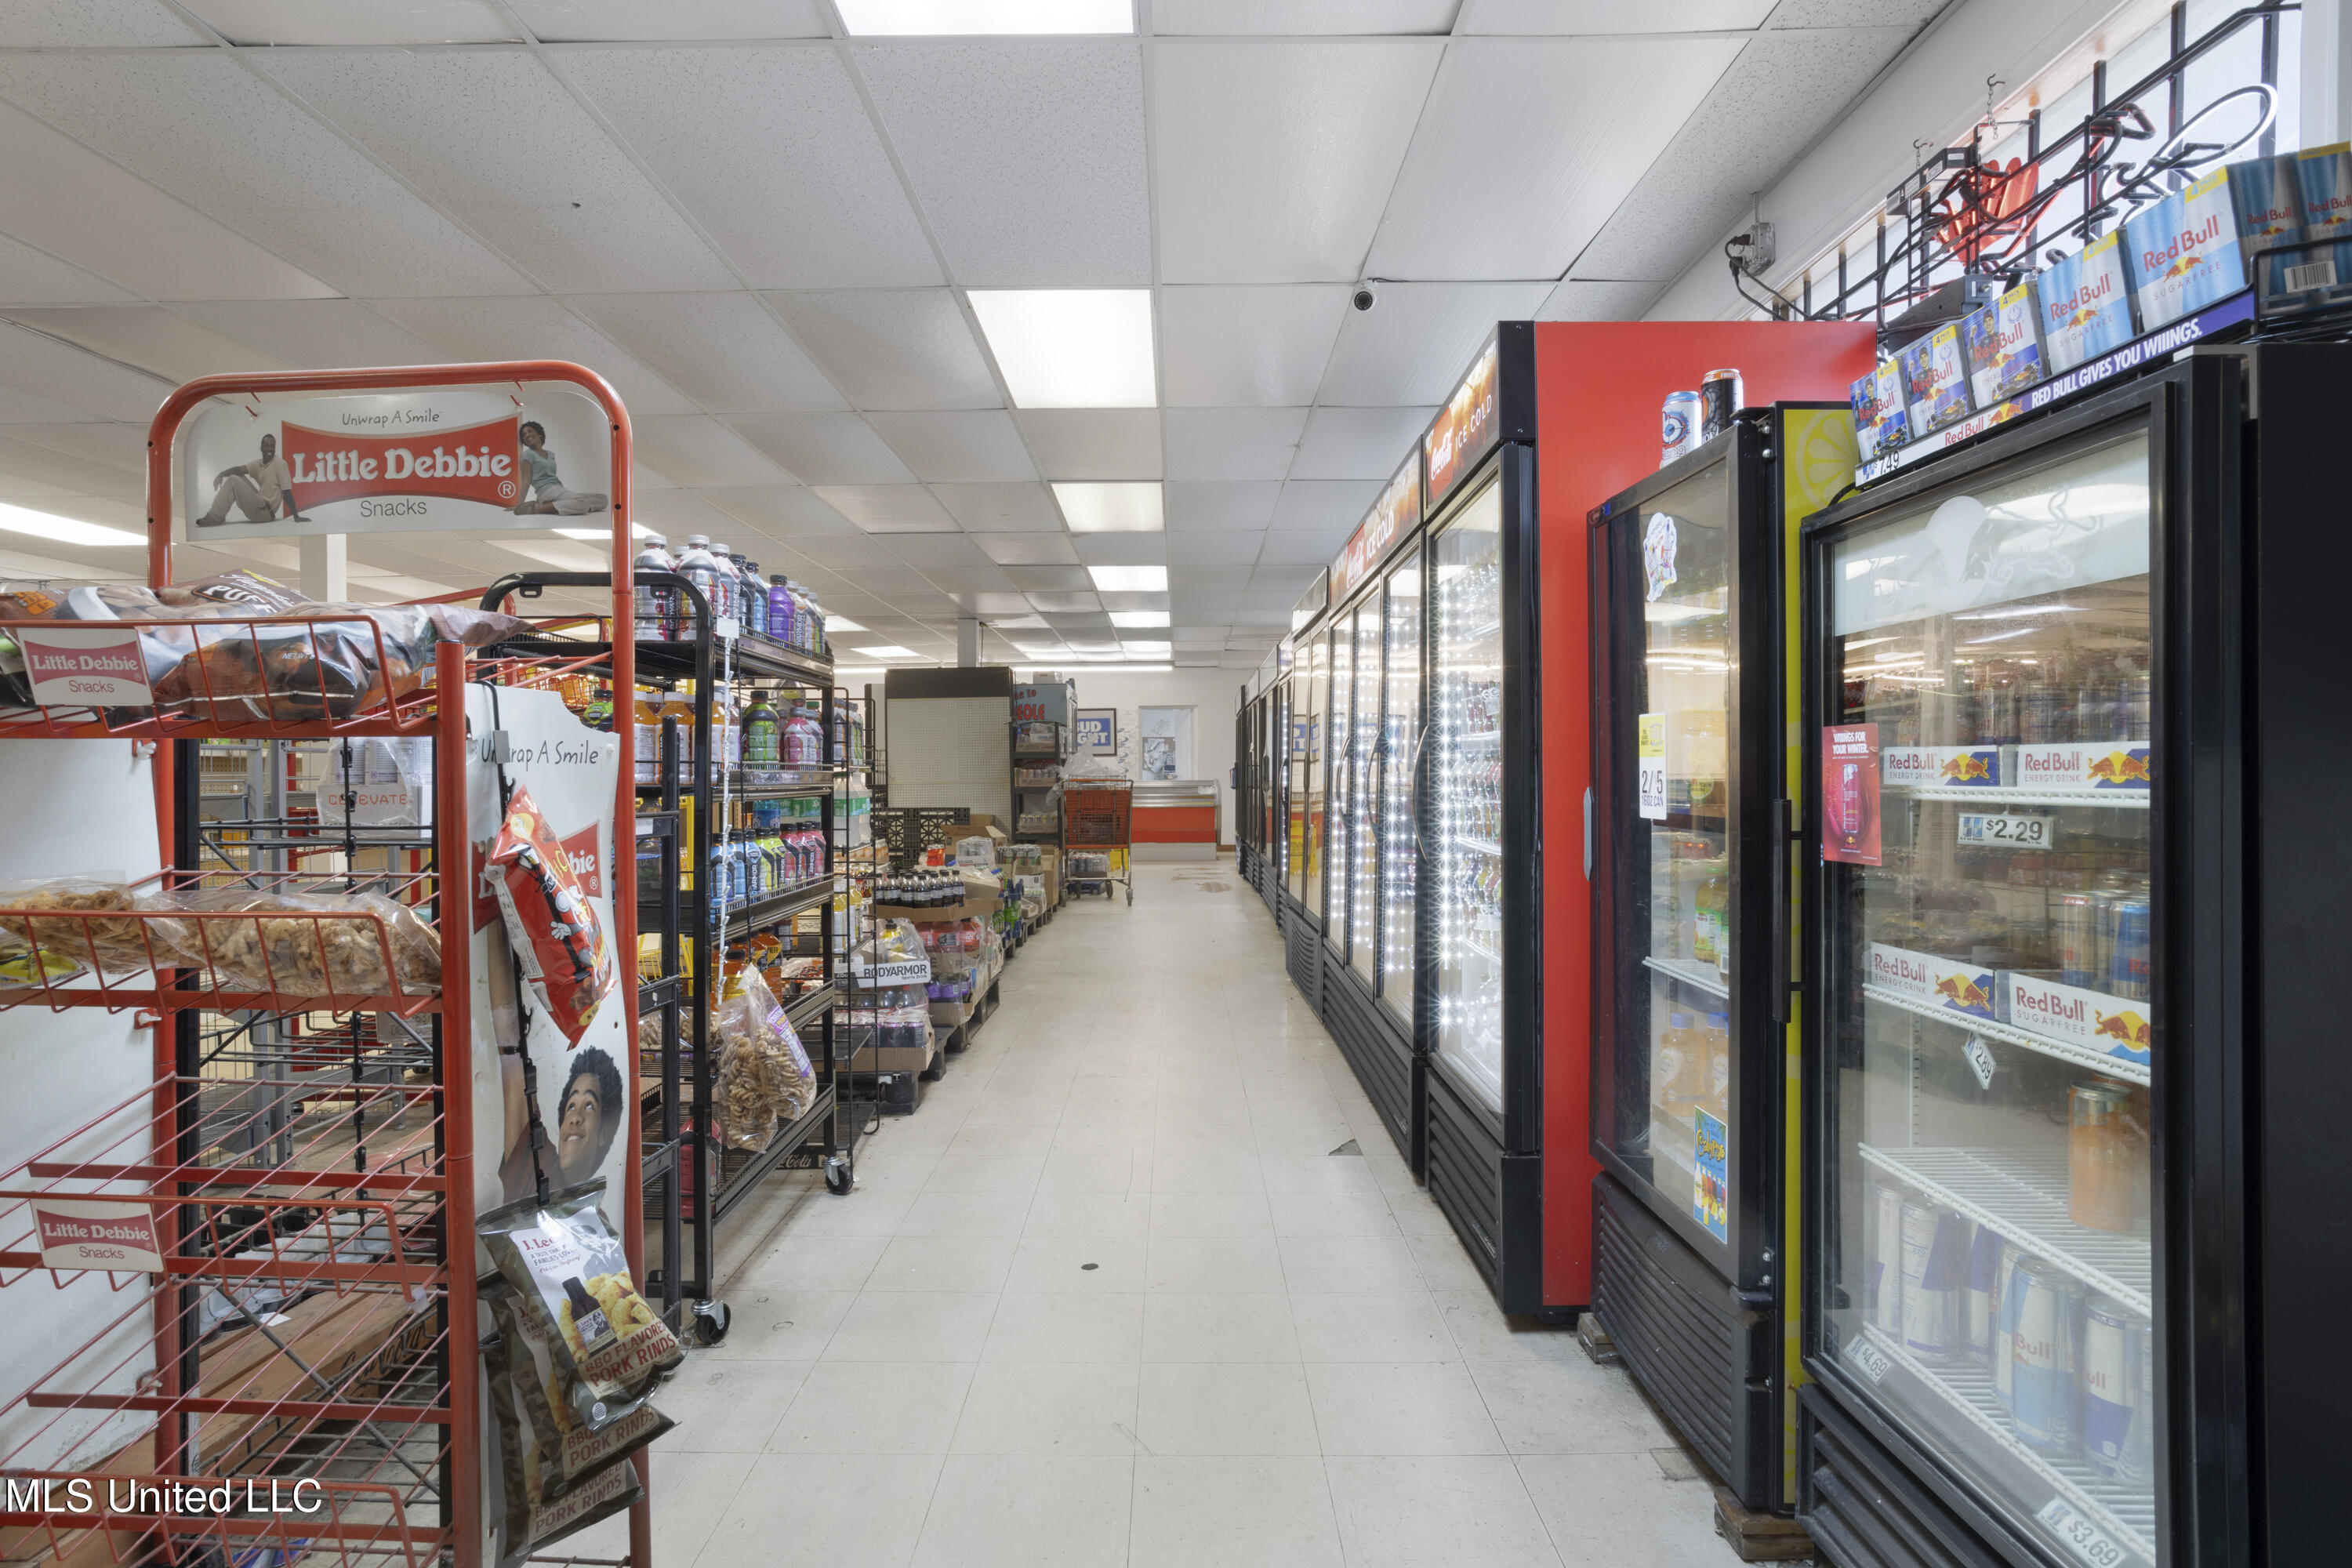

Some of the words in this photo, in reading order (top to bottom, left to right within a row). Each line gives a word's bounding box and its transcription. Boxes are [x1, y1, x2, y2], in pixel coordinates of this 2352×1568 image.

[2247, 210, 2267, 224] Red
[2270, 207, 2292, 220] Bull
[2308, 199, 2329, 213] Red
[2143, 237, 2179, 271] Red
[2181, 215, 2220, 252] Bull
[2154, 260, 2222, 301] SUGARFREE
[2050, 290, 2078, 321] Red
[2080, 274, 2111, 305] Bull
[1973, 335, 1998, 362] Red
[1999, 322, 2024, 348] Bull
[2060, 314, 2113, 347] SUGARFREE
[1911, 369, 1932, 394] Red
[1933, 360, 1953, 383] Bull
[2031, 387, 2051, 408] RED
[2053, 376, 2078, 401] BULL
[2079, 358, 2113, 388] GIVES
[2114, 344, 2140, 372] YOU
[342, 413, 388, 428] Unwrap
[391, 411, 401, 424] A
[405, 410, 440, 425] Smile
[1858, 400, 1877, 422] Red
[1877, 391, 1895, 412] Bull
[1456, 425, 1467, 452] ICE
[1470, 394, 1492, 433] COLD
[1945, 427, 1963, 447] Red
[1963, 416, 1984, 439] Bull
[292, 450, 379, 485] Little
[383, 445, 511, 479] Debbie
[360, 499, 426, 517] Snacks
[1367, 531, 1376, 561] ICE
[1376, 510, 1394, 548] COLD
[31, 655, 78, 670] Little
[79, 655, 139, 671] Debbie
[69, 680, 114, 693] Snacks
[1077, 720, 1102, 732] UD
[1855, 731, 1866, 742] FOR
[481, 739, 533, 771] Unrap
[537, 740, 550, 764] A
[555, 740, 599, 764] Smile
[1833, 745, 1847, 754] YOUR
[1889, 753, 1911, 771] Red
[1912, 752, 1935, 770] Bull
[2025, 753, 2051, 771] Red
[2053, 750, 2081, 771] Bull
[1889, 771, 1913, 780] ENERGY
[1915, 771, 1935, 780] DRINK
[2025, 774, 2053, 782] ENERGY
[2056, 774, 2081, 782] DRINK
[328, 793, 408, 806] CEEVATE
[1653, 796, 1664, 808] CAN
[1986, 819, 2043, 842] $2.29
[864, 965, 927, 978] BODYARMOR
[1875, 954, 1899, 976] Red
[1900, 960, 1926, 983] Bull
[1875, 975, 1903, 991] ENERGY
[1904, 982, 1926, 995] DRINK
[2016, 986, 2048, 1010] Red
[2050, 994, 2085, 1022] Bull
[2016, 1008, 2086, 1036] SUGARFREE
[43, 1223, 89, 1238] Little
[91, 1225, 150, 1241] Debbie
[78, 1246, 125, 1260] Snacks
[585, 1352, 612, 1373] BBQ
[615, 1320, 666, 1356] FLAVORED
[2016, 1332, 2051, 1360] Bull
[590, 1354, 633, 1388] PORK
[637, 1334, 677, 1366] RINDS
[570, 1433, 612, 1468] PORK
[616, 1411, 654, 1443] RINDS
[535, 1502, 577, 1534] PORK
[583, 1474, 622, 1510] RINDS
[2068, 1521, 2119, 1566] $3.69
